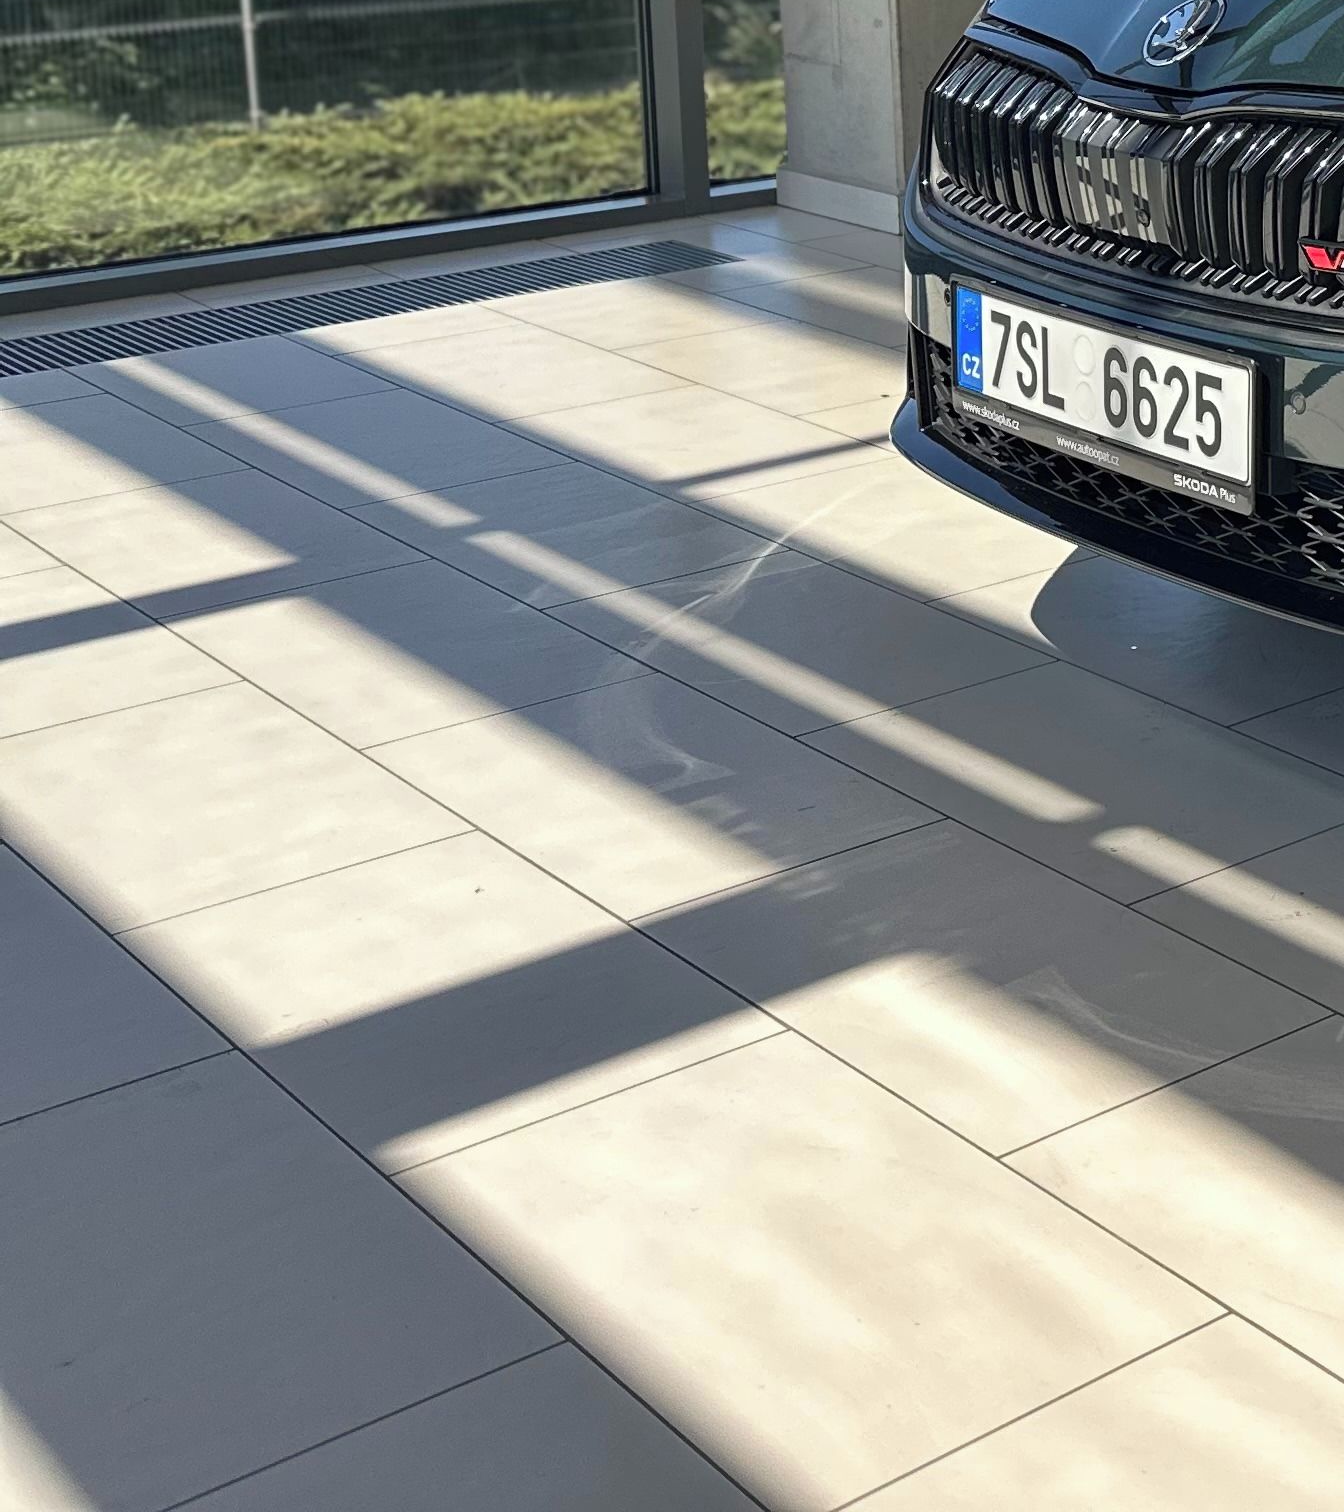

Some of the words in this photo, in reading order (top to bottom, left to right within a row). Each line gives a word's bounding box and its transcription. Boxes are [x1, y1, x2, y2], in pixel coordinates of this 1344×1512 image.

[962, 353, 981, 379] CZ
[990, 309, 1065, 411] 7SL
[1103, 346, 1223, 458] 6625
[1056, 436, 1120, 467] www.autoopat.cz
[1219, 487, 1236, 504] Plus
